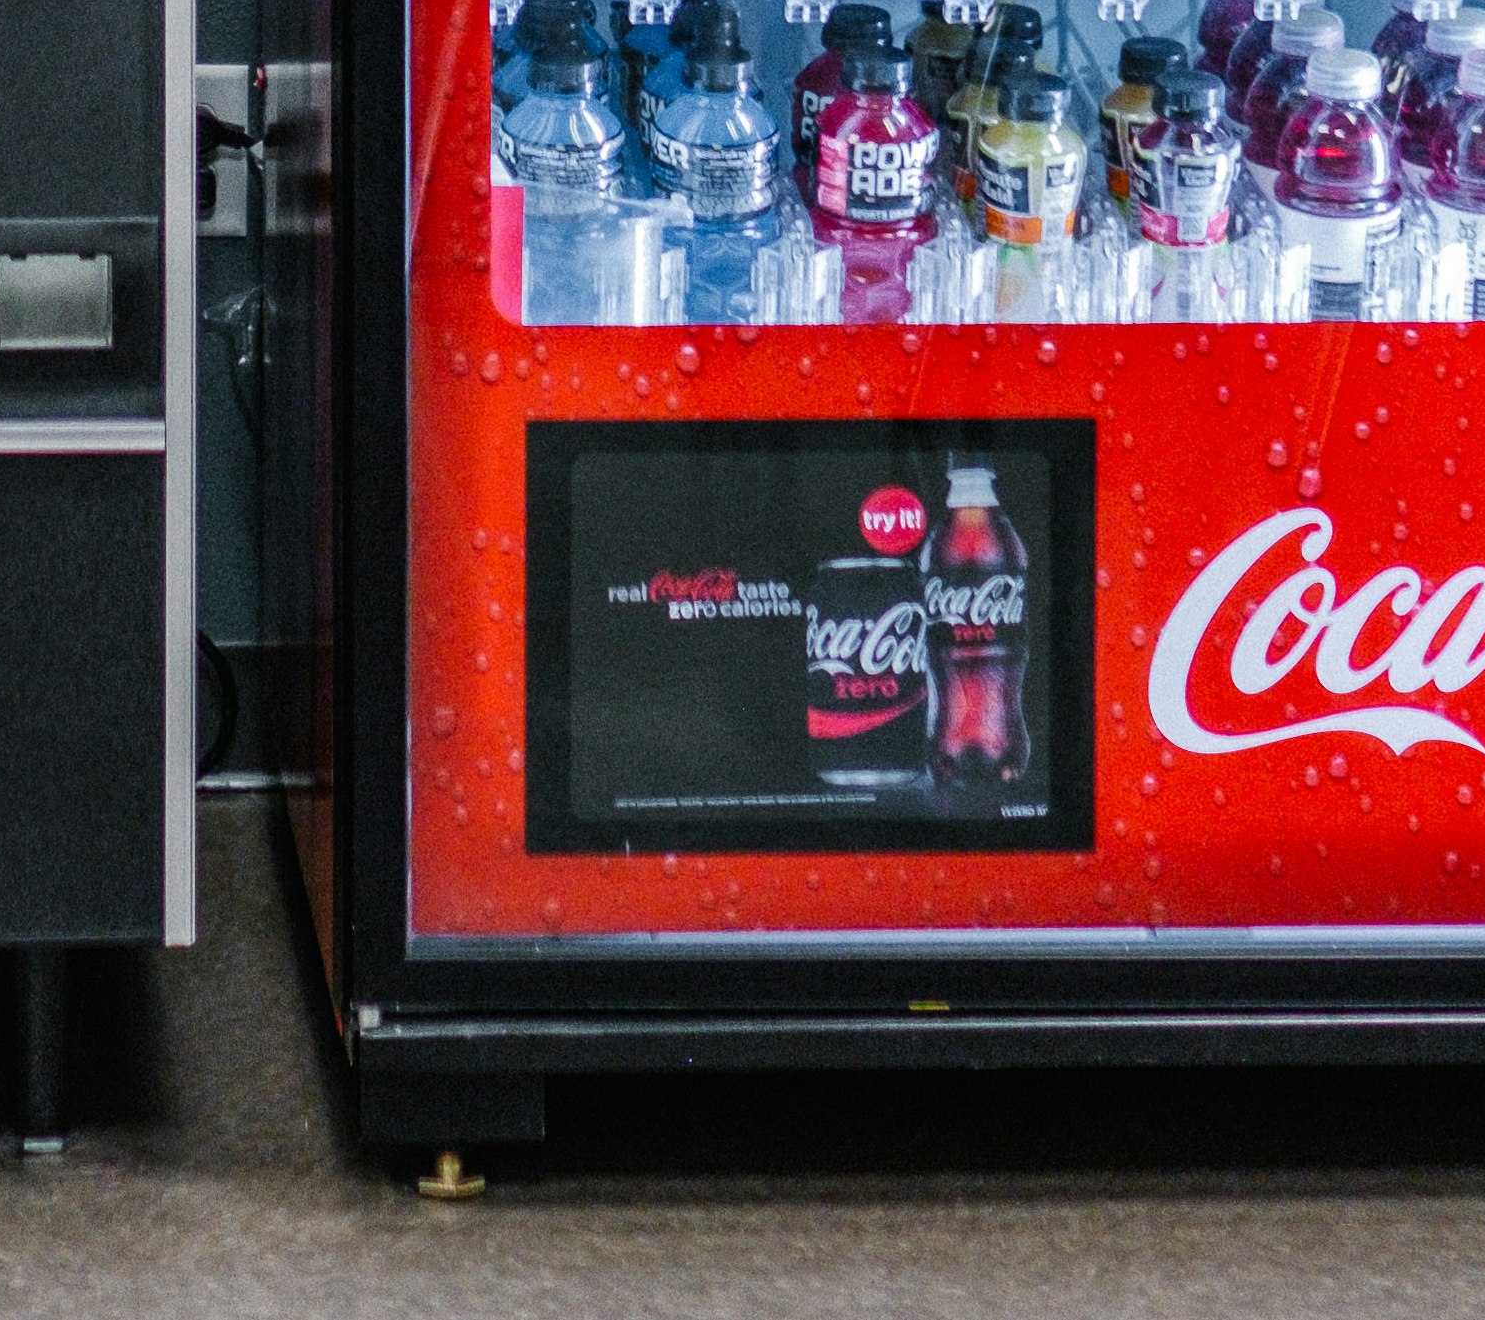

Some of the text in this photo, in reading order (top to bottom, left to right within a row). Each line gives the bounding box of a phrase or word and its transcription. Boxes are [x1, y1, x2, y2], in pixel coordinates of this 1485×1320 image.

[862, 508, 922, 533] try it!
[608, 583, 648, 603] real
[738, 580, 790, 600] taste
[668, 596, 802, 619] zero calories
[835, 674, 899, 699] zero
